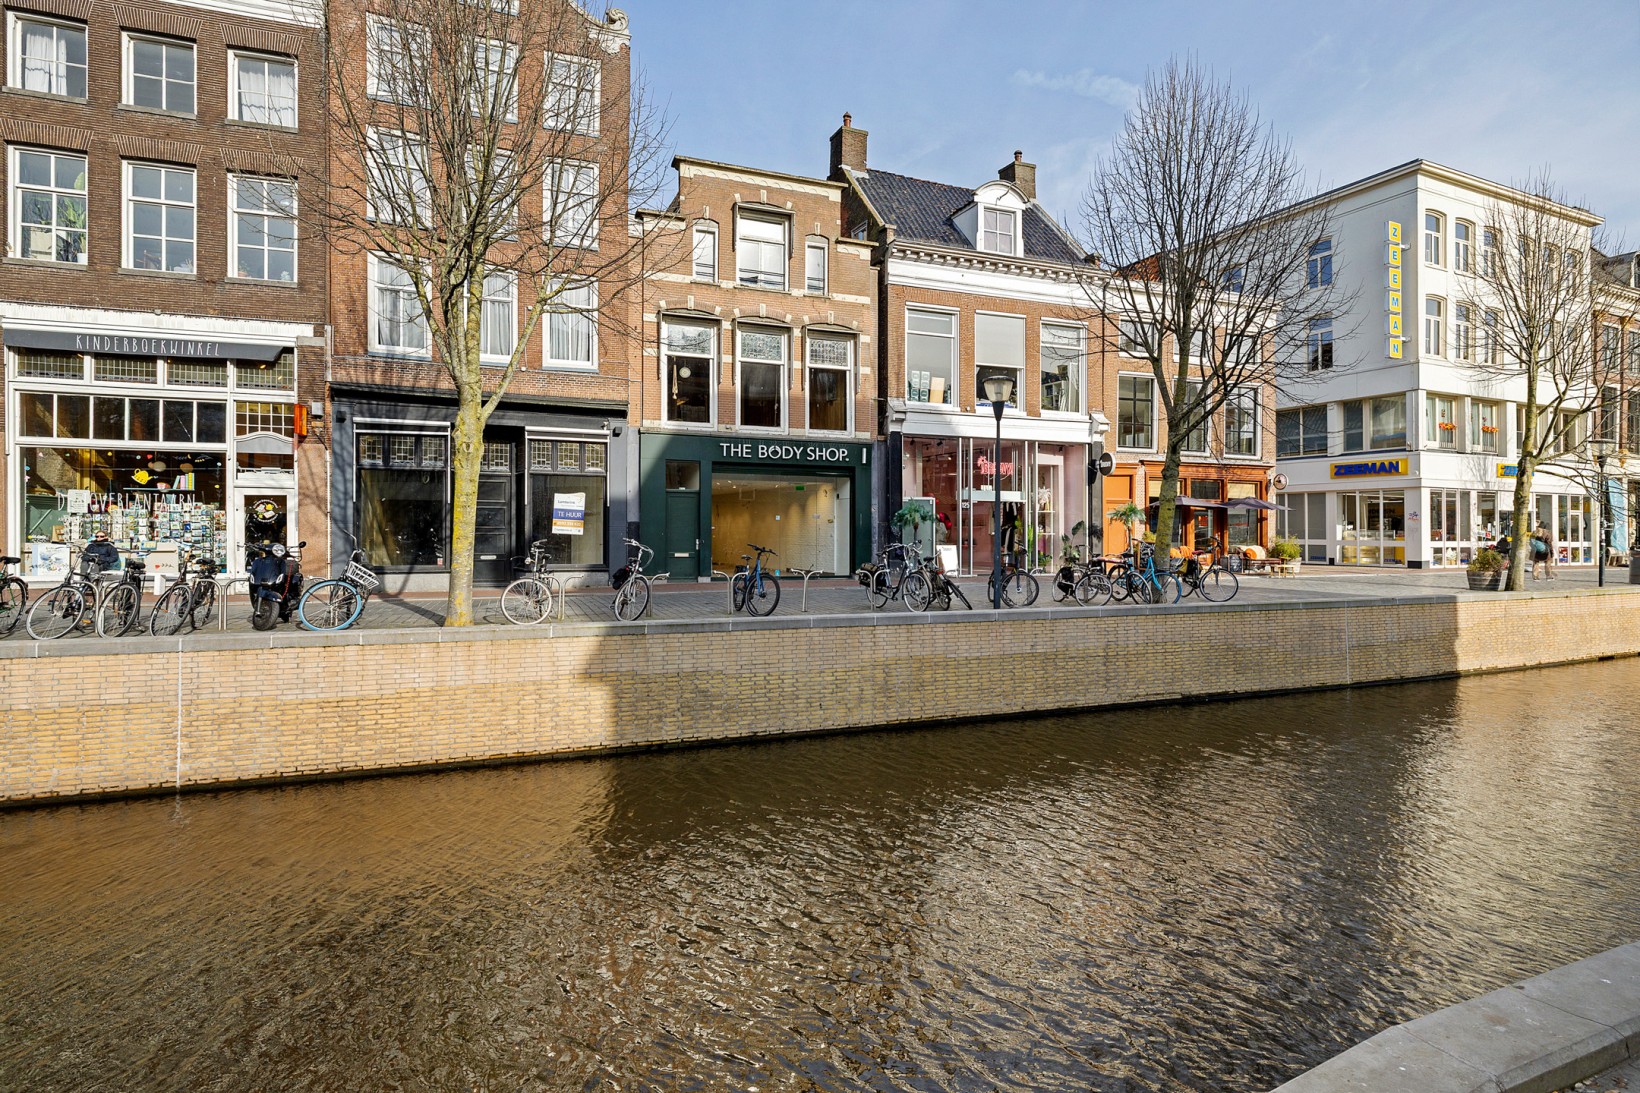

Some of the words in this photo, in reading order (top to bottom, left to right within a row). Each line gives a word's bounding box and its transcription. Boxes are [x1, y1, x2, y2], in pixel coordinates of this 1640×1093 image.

[1391, 227, 1399, 353] ZEEMAN
[76, 334, 220, 356] KINDERBOEKWINKEL
[720, 443, 752, 458] THE
[758, 445, 804, 459] BODY
[1334, 461, 1401, 476] ZEEMAN
